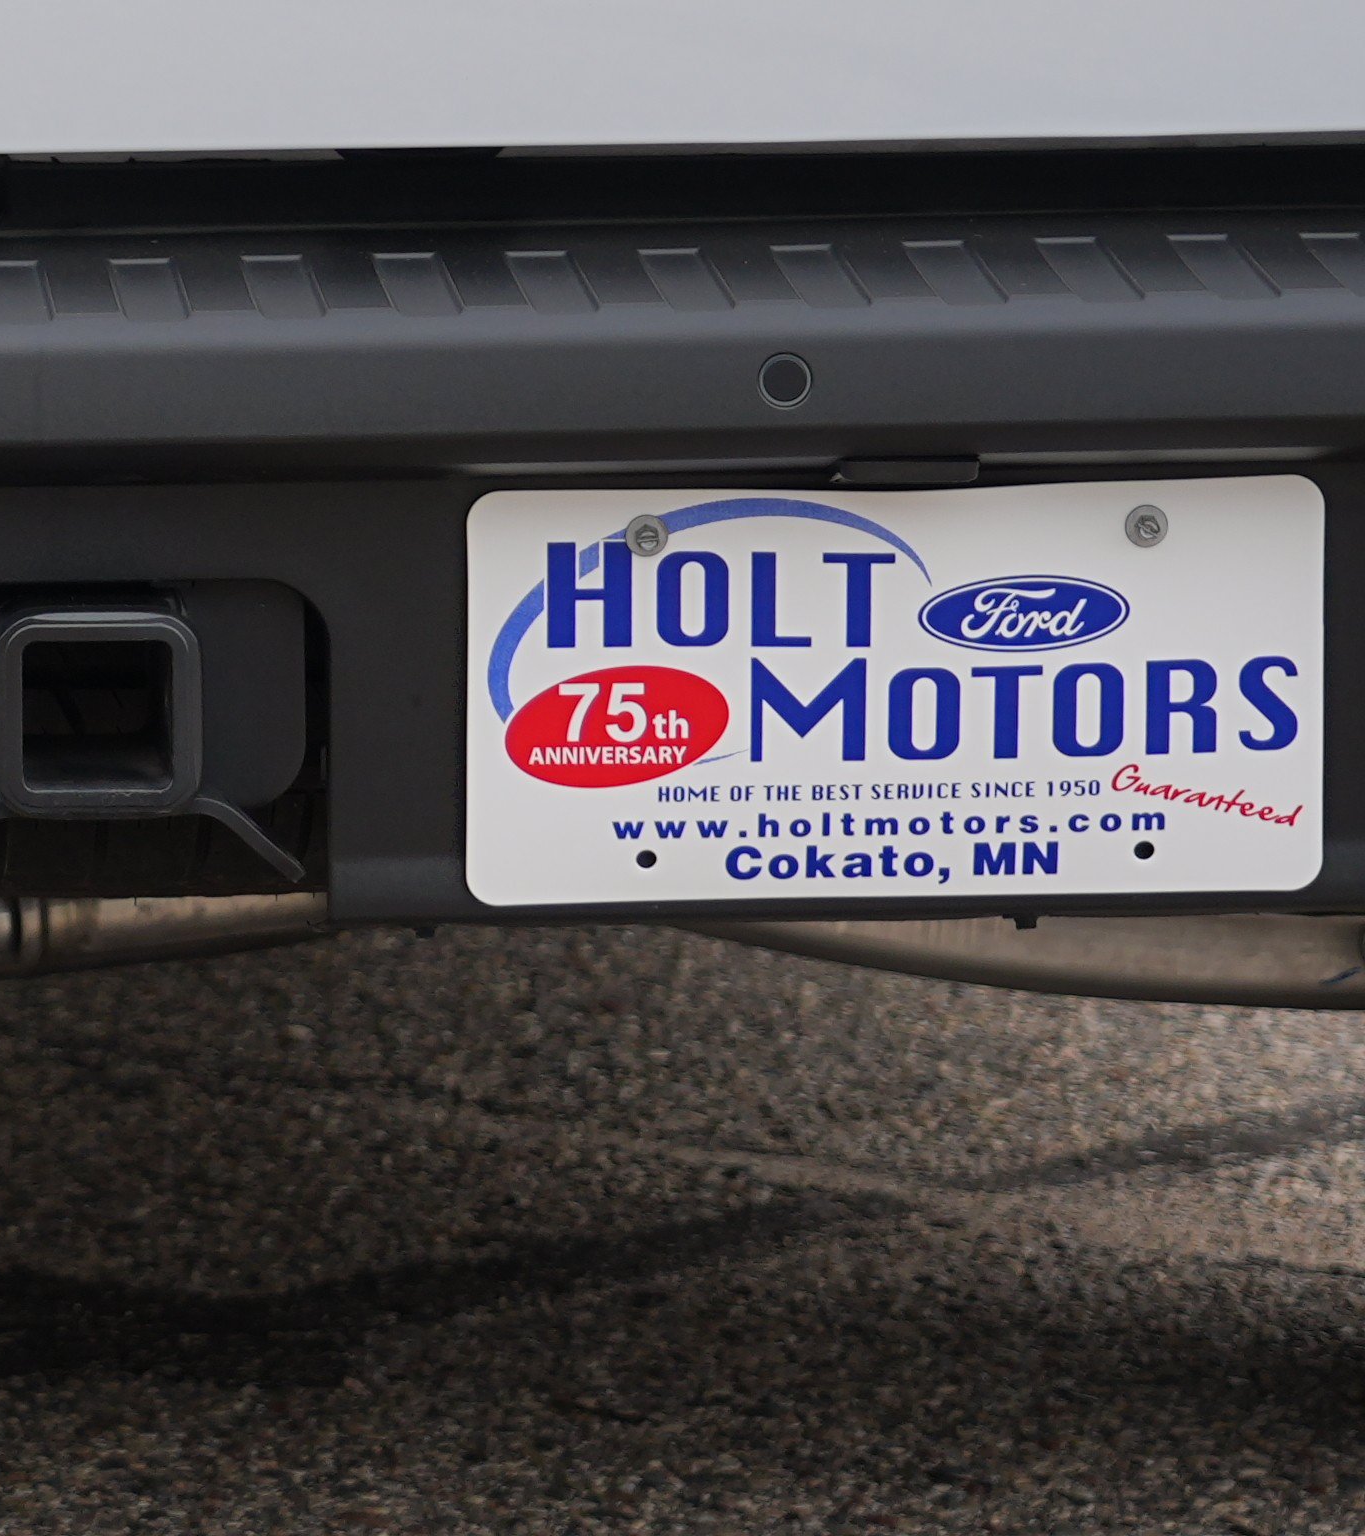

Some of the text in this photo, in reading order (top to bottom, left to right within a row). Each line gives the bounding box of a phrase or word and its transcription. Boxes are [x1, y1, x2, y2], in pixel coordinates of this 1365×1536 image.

[545, 541, 896, 649] HOLT
[960, 585, 1087, 642] Ford
[558, 682, 691, 743] 75th
[749, 654, 1300, 763] MOTORS
[527, 745, 687, 765] ANNIVERSARY
[657, 779, 1102, 803] HOME OF THE BEST SERVICE SINCE 1950
[1110, 763, 1304, 828] Guaranteed
[612, 810, 1166, 840] www.holtmotors.com
[725, 841, 1060, 885] Cokato, MN
